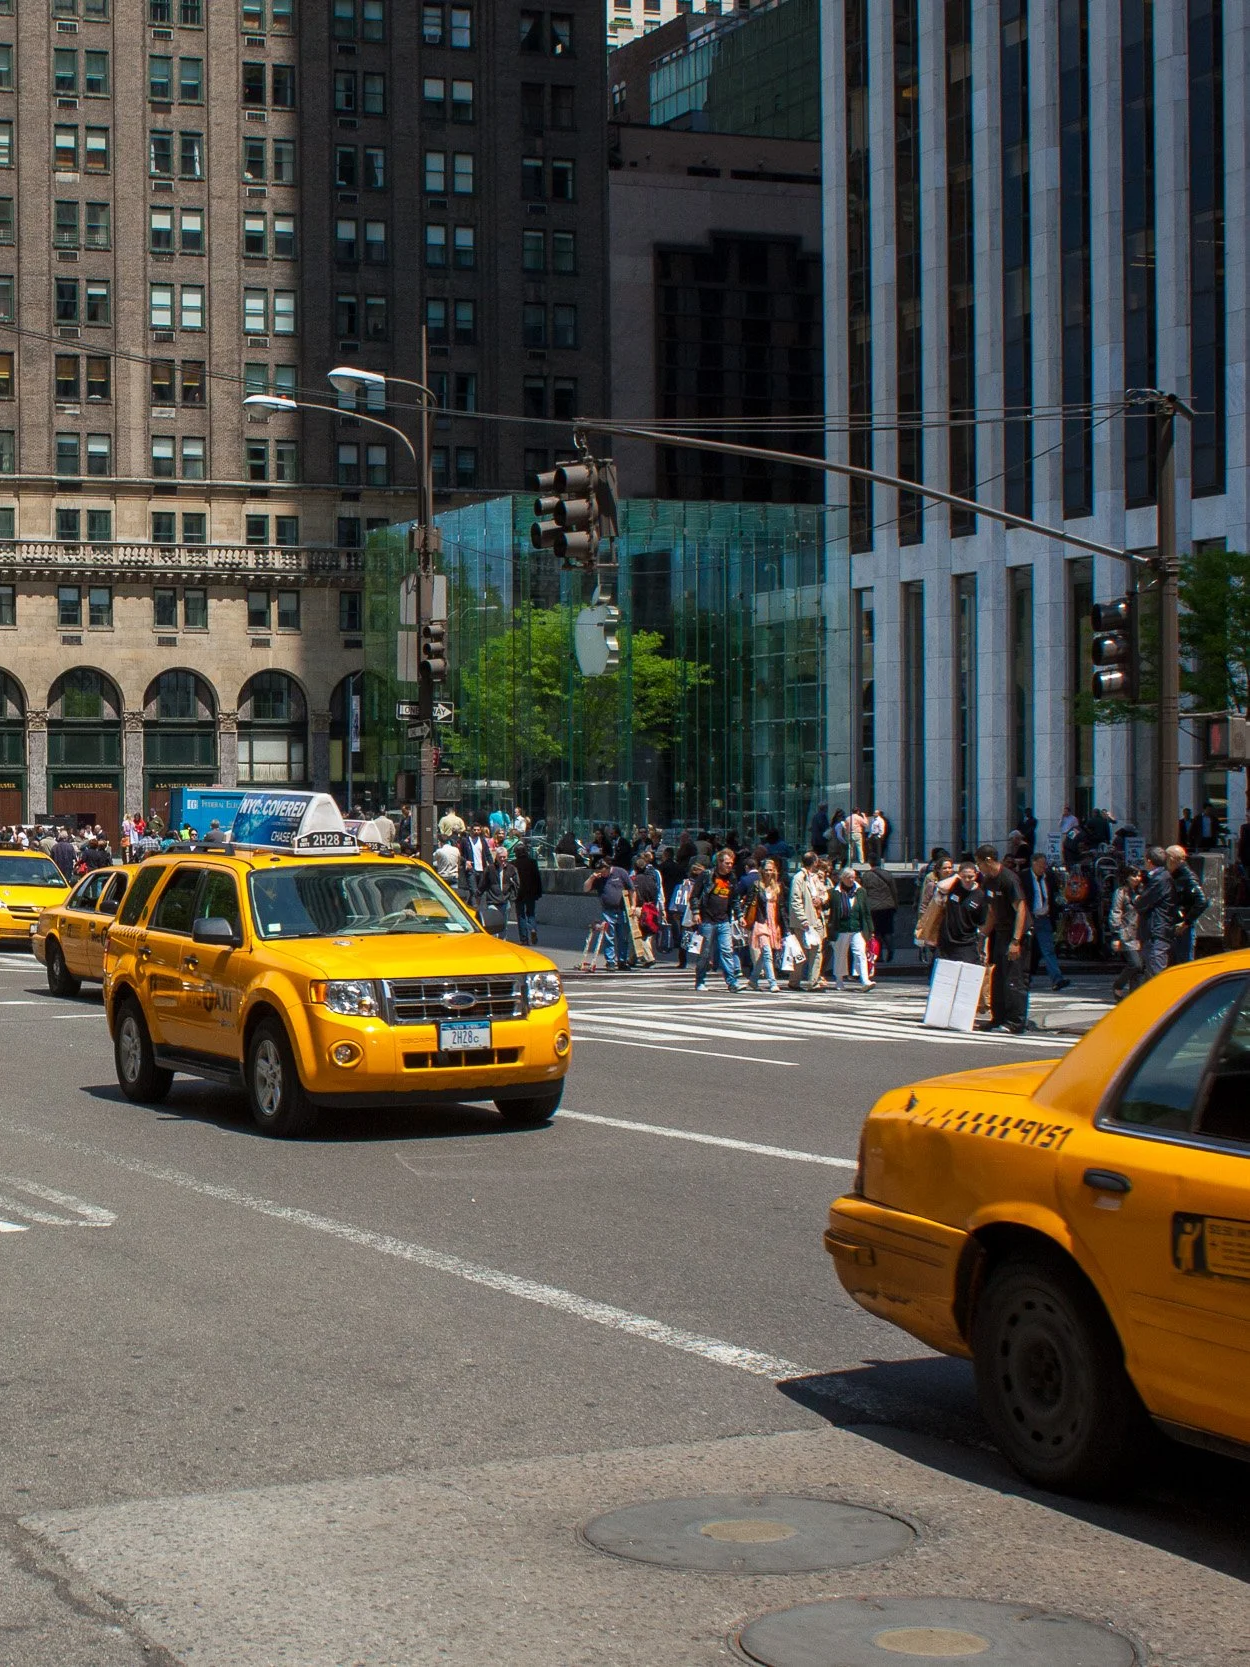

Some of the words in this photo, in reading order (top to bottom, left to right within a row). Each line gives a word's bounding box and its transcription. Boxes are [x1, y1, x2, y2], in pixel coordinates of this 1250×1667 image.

[262, 799, 306, 817] COVERED
[271, 831, 291, 842] CHASE
[313, 834, 340, 846] 2H28
[1020, 1121, 1074, 1150] 9Y51
